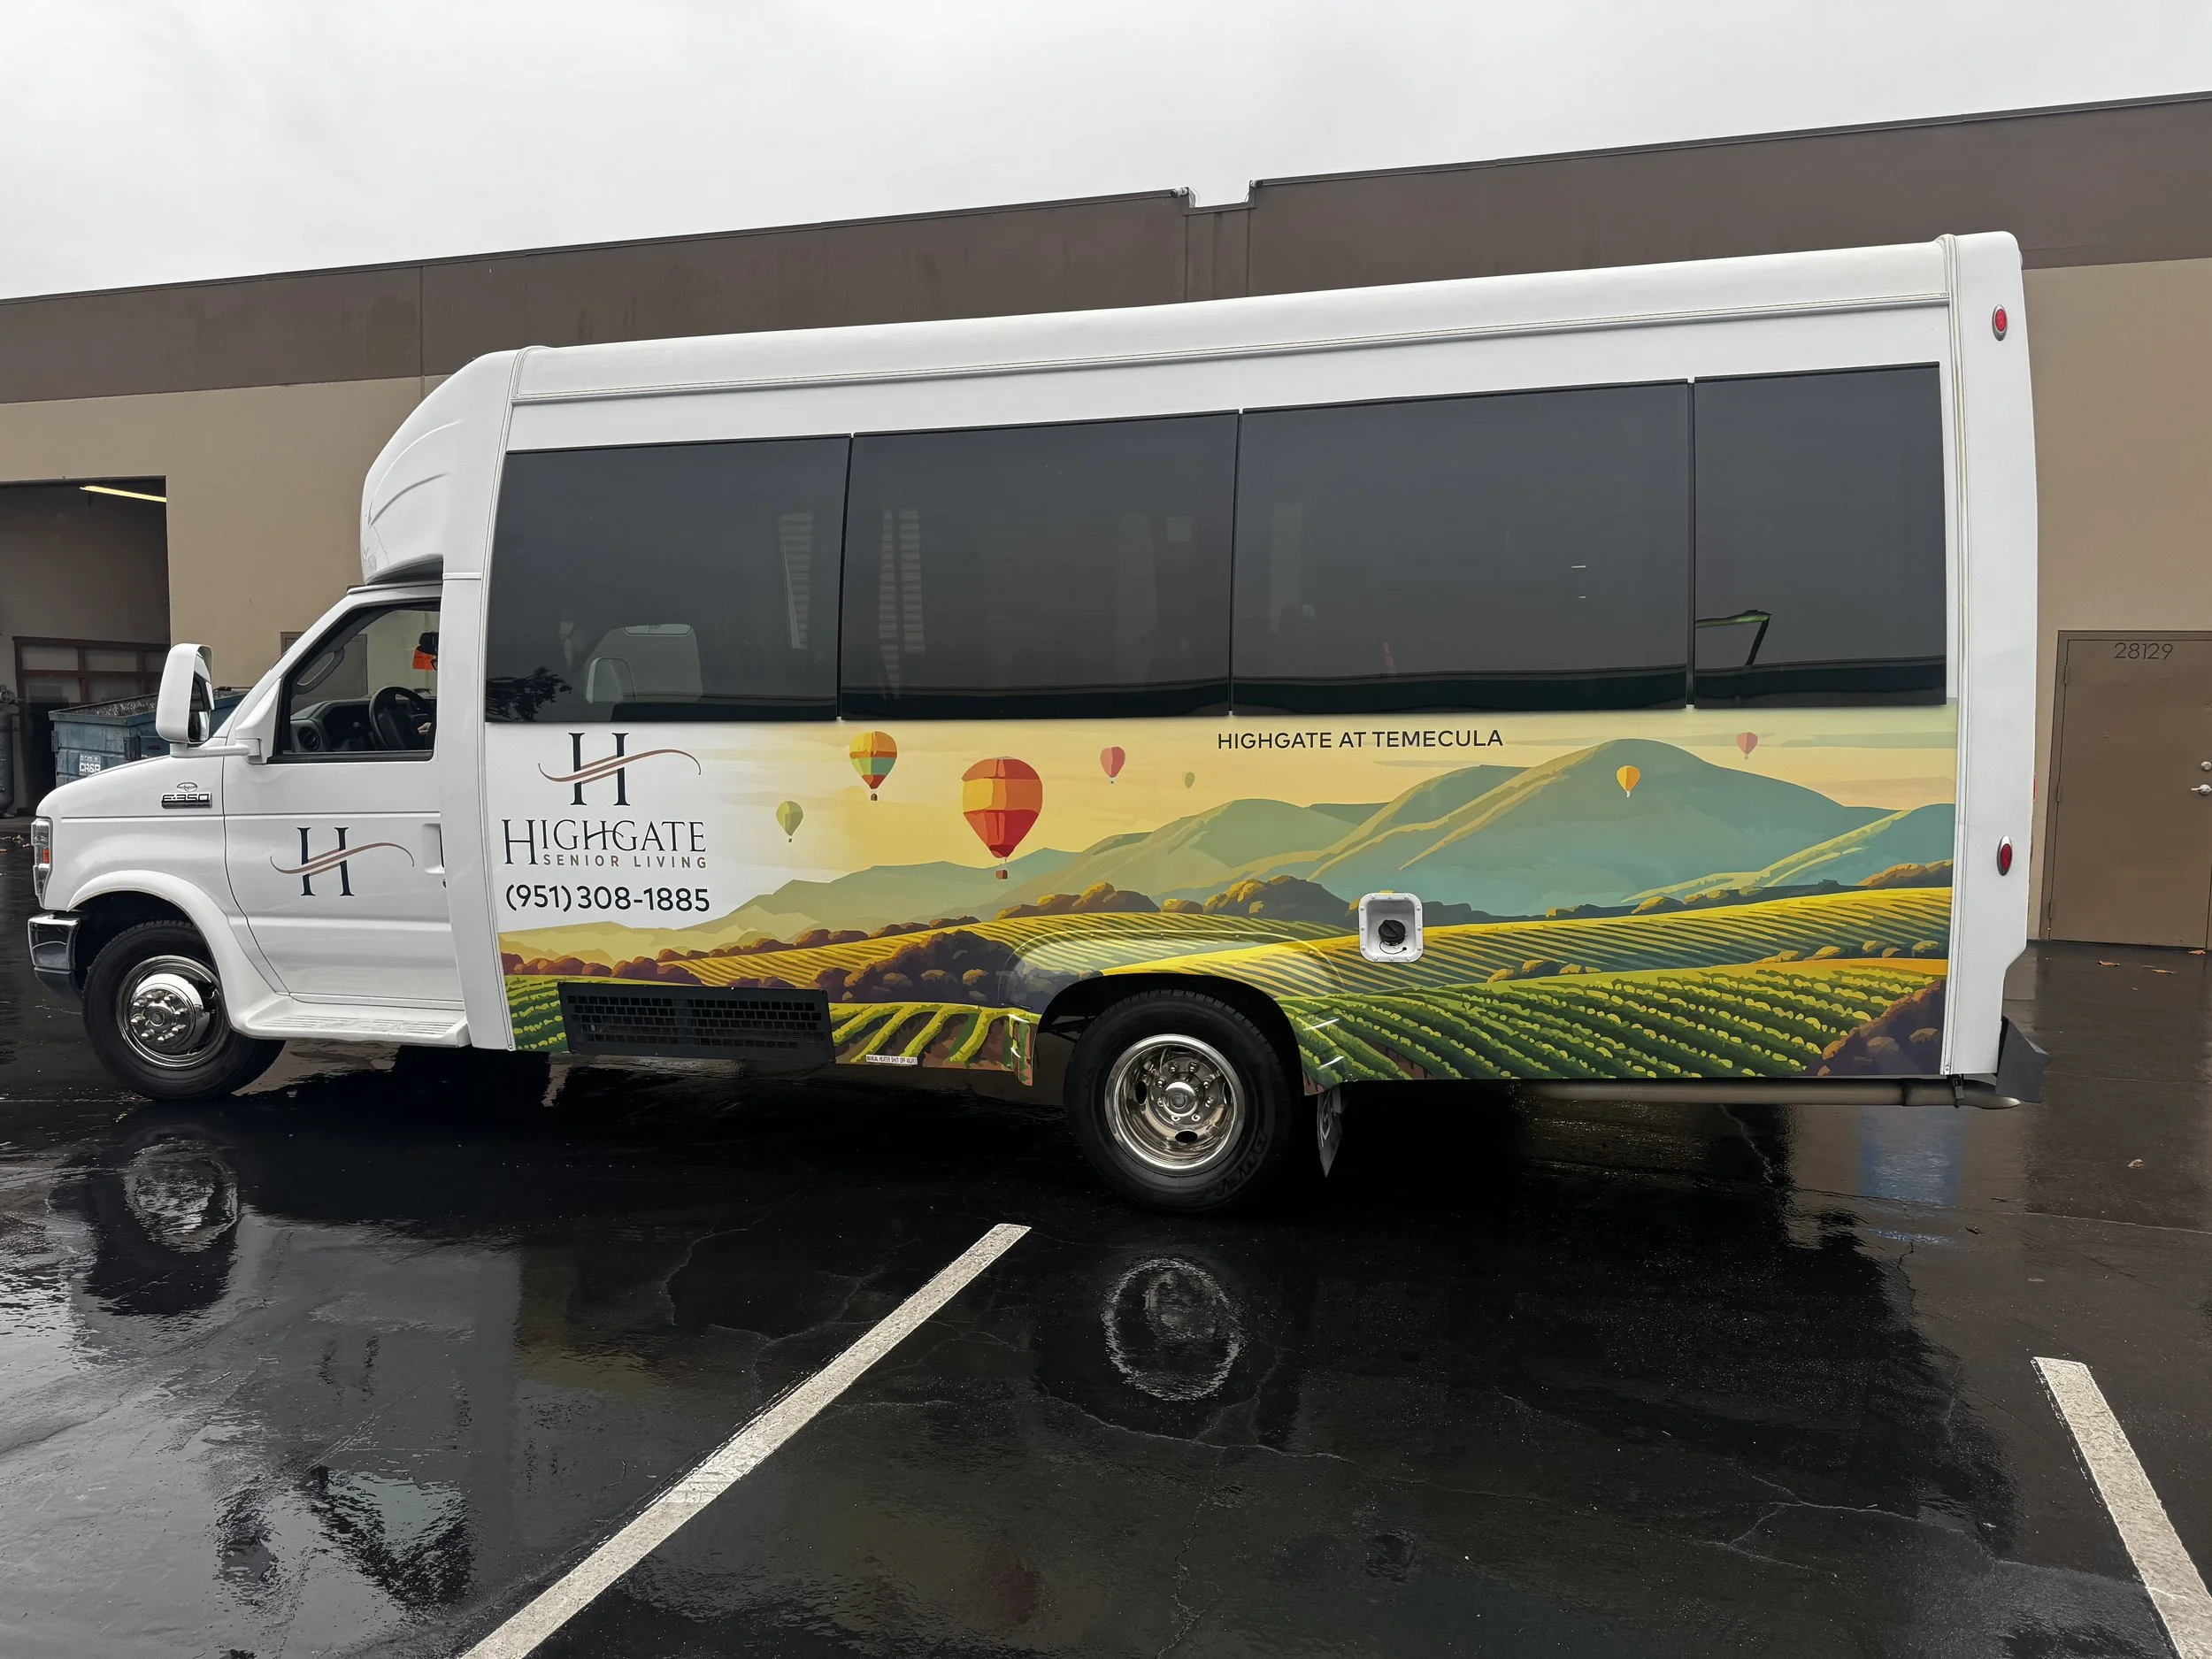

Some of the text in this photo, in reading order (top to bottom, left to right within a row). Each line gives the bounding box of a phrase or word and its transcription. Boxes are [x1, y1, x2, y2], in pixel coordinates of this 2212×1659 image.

[2114, 642, 2173, 660] 28129
[1217, 730, 1503, 749] HIGHGATE AT TEMECULA
[501, 819, 706, 864] HIGHGATE
[543, 854, 706, 868] SENIOR LIVING
